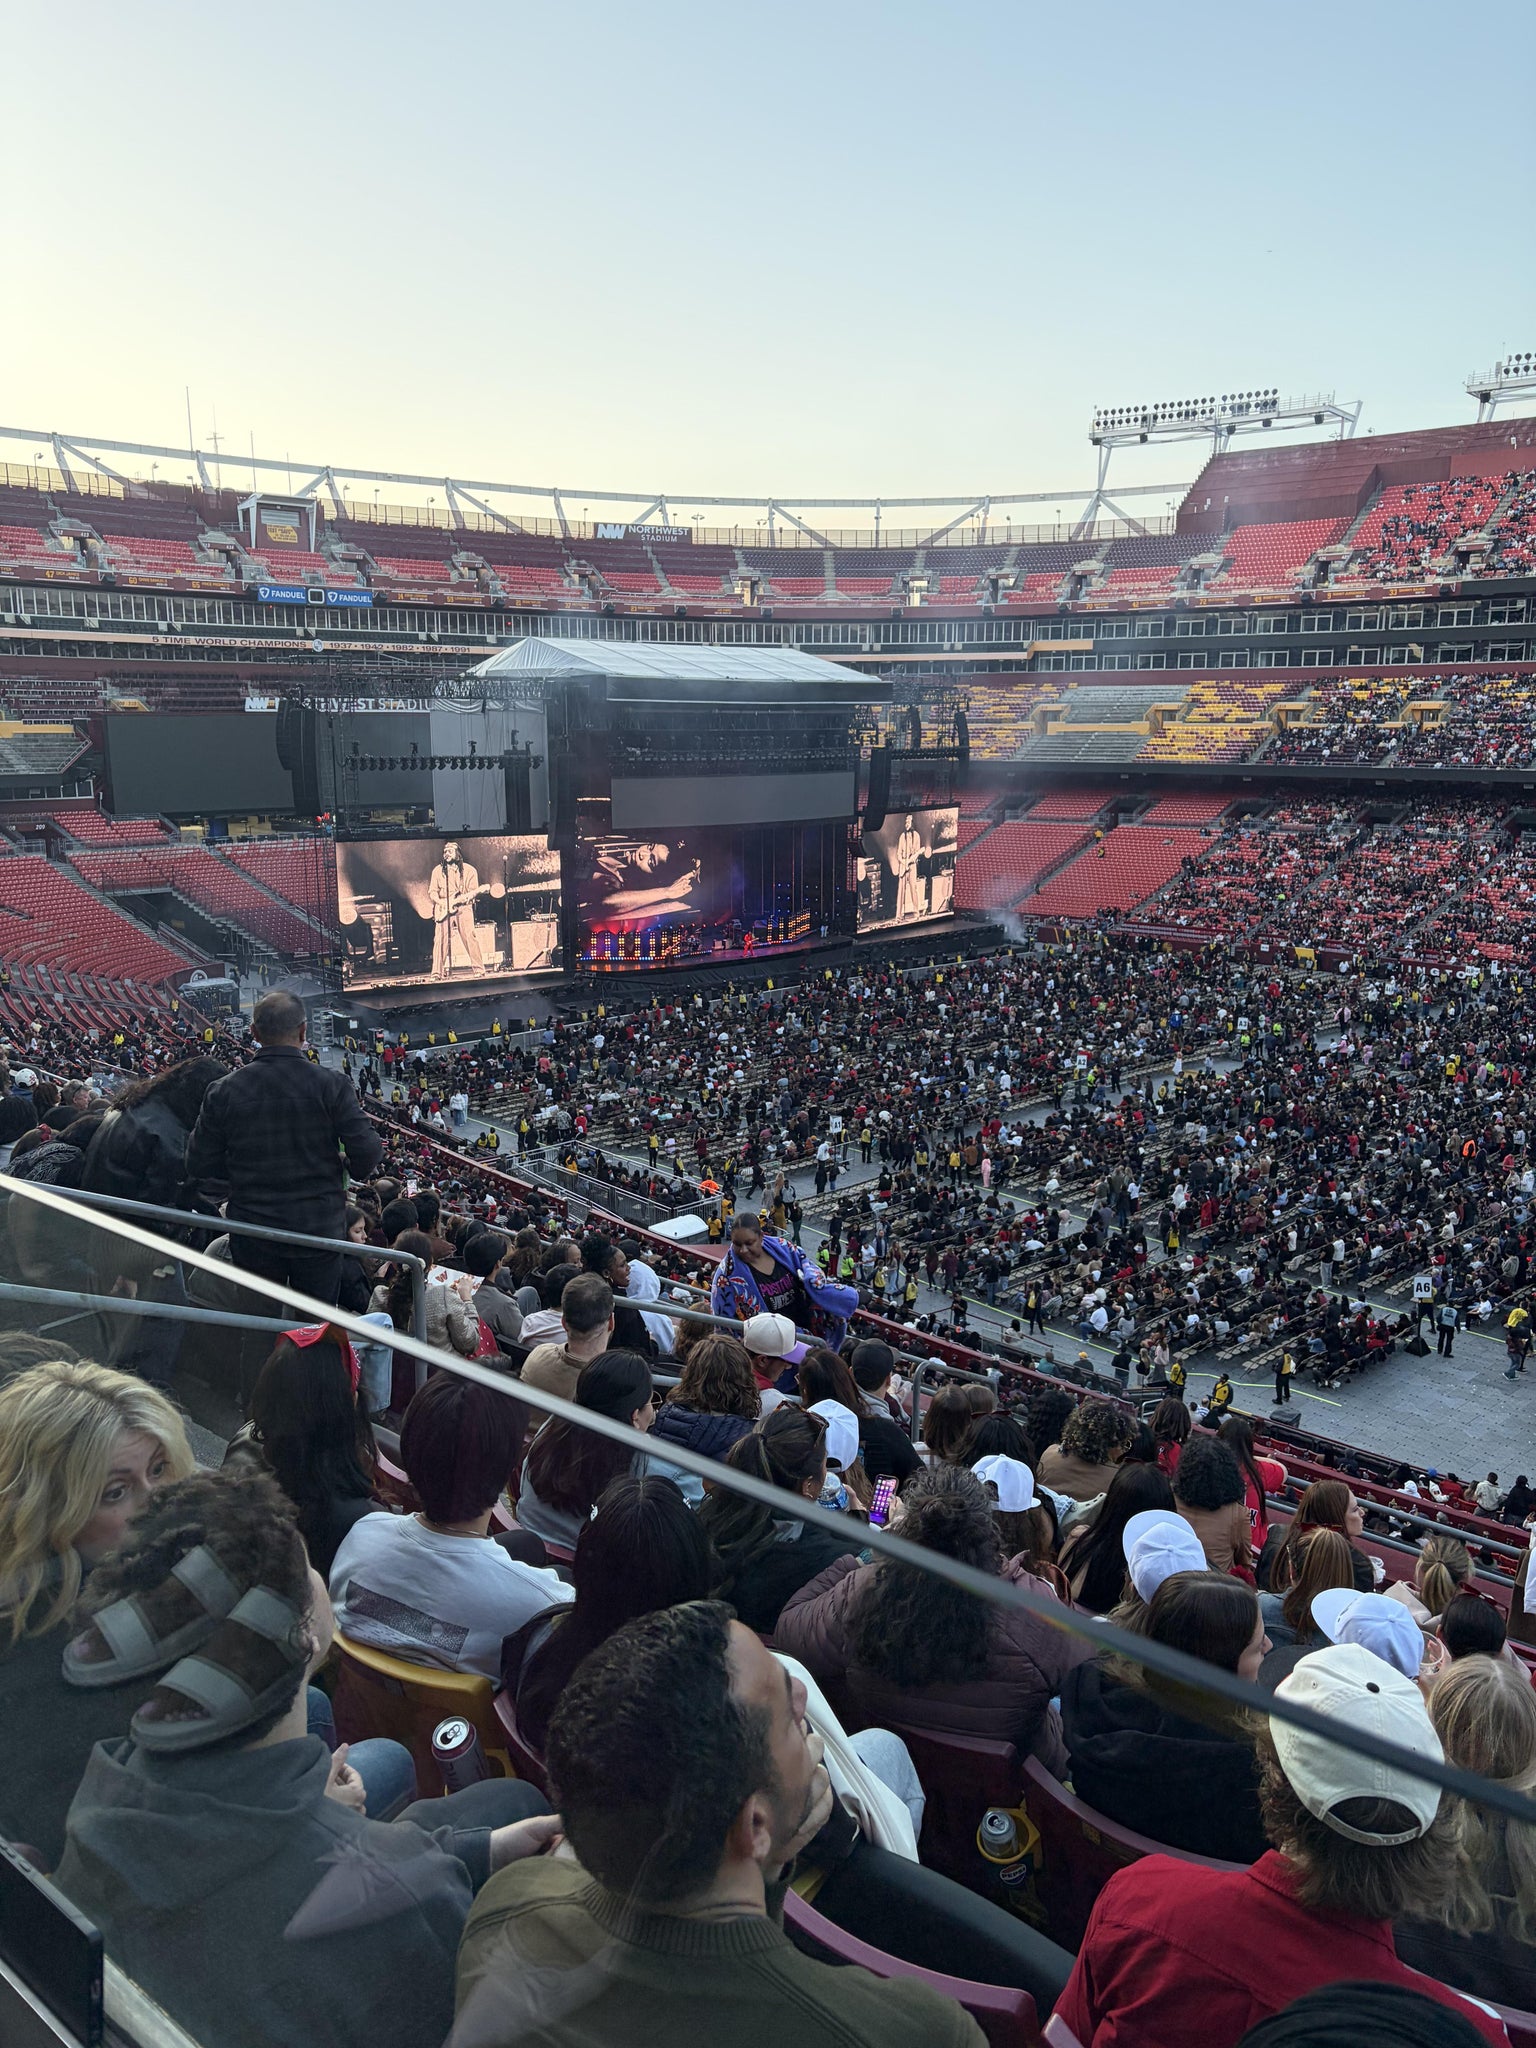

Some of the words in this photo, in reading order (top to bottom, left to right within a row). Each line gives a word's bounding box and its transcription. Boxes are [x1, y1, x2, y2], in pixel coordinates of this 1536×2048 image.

[597, 523, 627, 539] NW
[628, 525, 689, 536] NORTHWEST
[641, 534, 678, 542] STADIUM
[45, 570, 55, 578] 47
[271, 590, 305, 599] FANDUEL
[339, 594, 372, 603] FANDUEL
[163, 636, 191, 644] TIME
[194, 638, 237, 646] WORLD
[240, 639, 307, 648] CHAMPIONS
[834, 1121, 841, 1129] A1
[1415, 1282, 1431, 1293] A6
[1001, 1865, 1026, 1879] PEPSI
